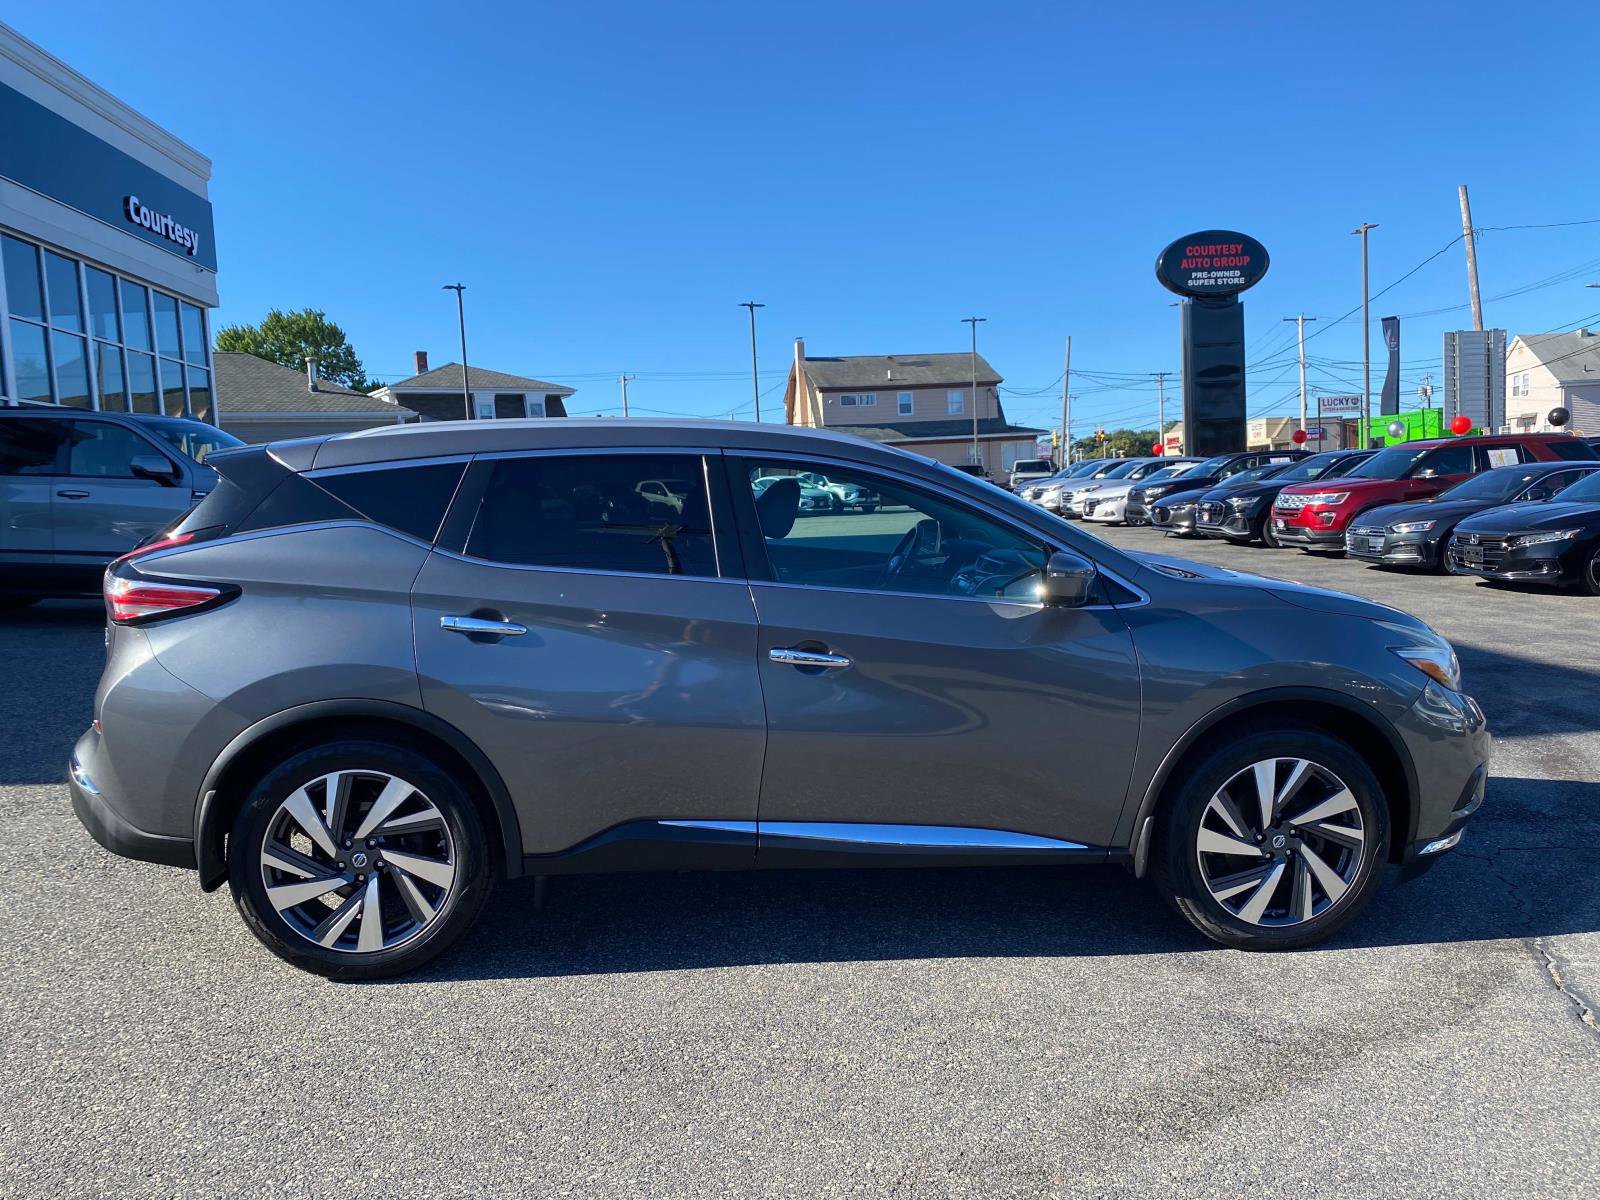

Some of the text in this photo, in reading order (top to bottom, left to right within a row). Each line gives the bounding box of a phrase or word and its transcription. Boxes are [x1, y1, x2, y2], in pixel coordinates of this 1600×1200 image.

[125, 195, 199, 256] Courtesy
[1186, 244, 1242, 256] COURTESY
[1181, 255, 1250, 269] AUTO GROUP
[1191, 270, 1241, 279] PRE-OWNED
[1218, 277, 1245, 285] STORE
[1322, 397, 1350, 407] LUCKY
